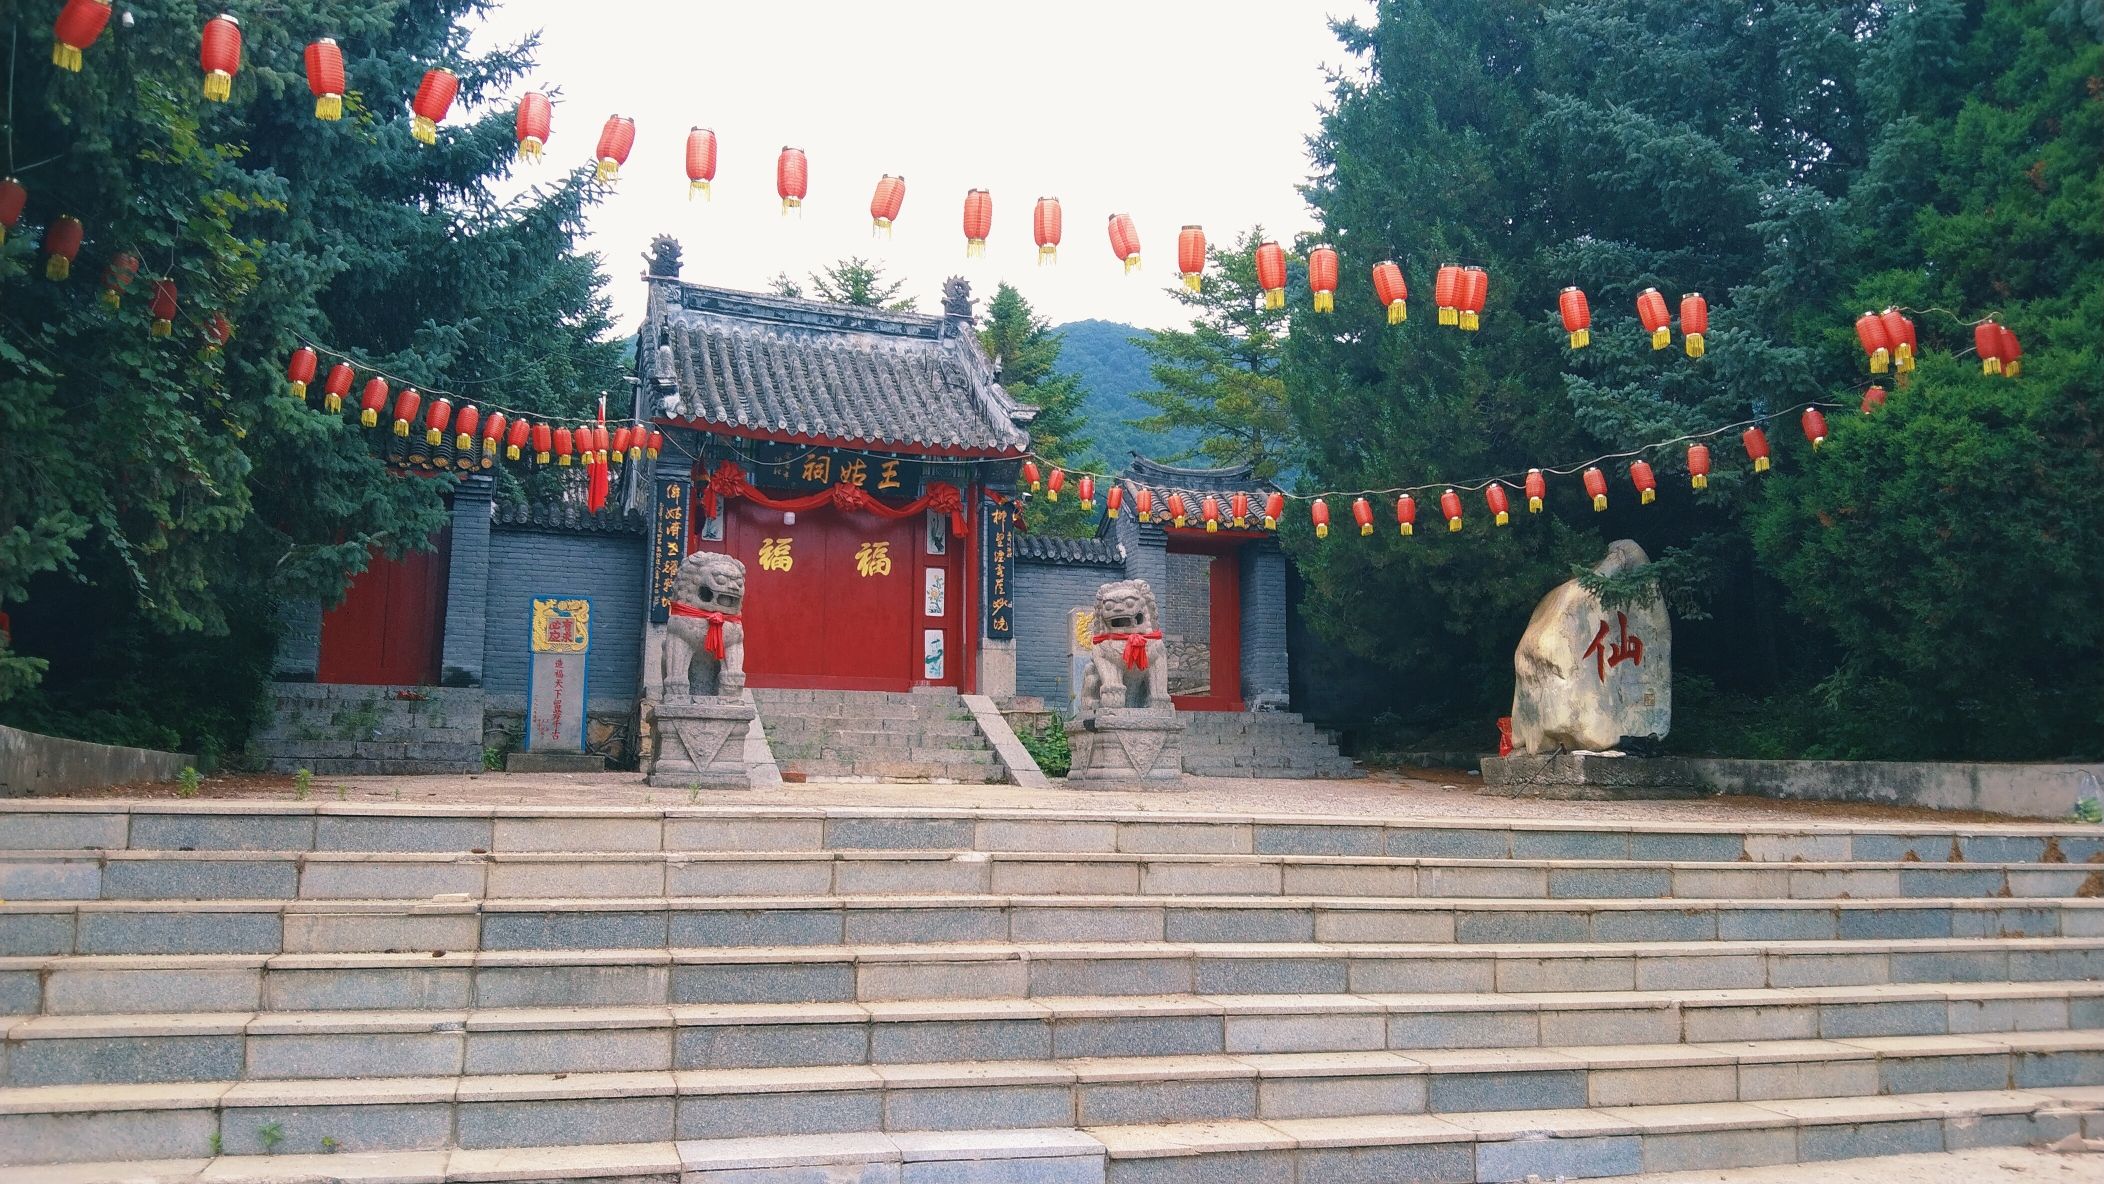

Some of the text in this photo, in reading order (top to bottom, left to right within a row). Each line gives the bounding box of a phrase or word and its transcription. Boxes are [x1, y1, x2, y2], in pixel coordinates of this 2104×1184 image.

[802, 453, 900, 490] 王姑祠
[758, 538, 794, 572] 福
[855, 541, 892, 577] 福
[1582, 611, 1643, 683] 仙
